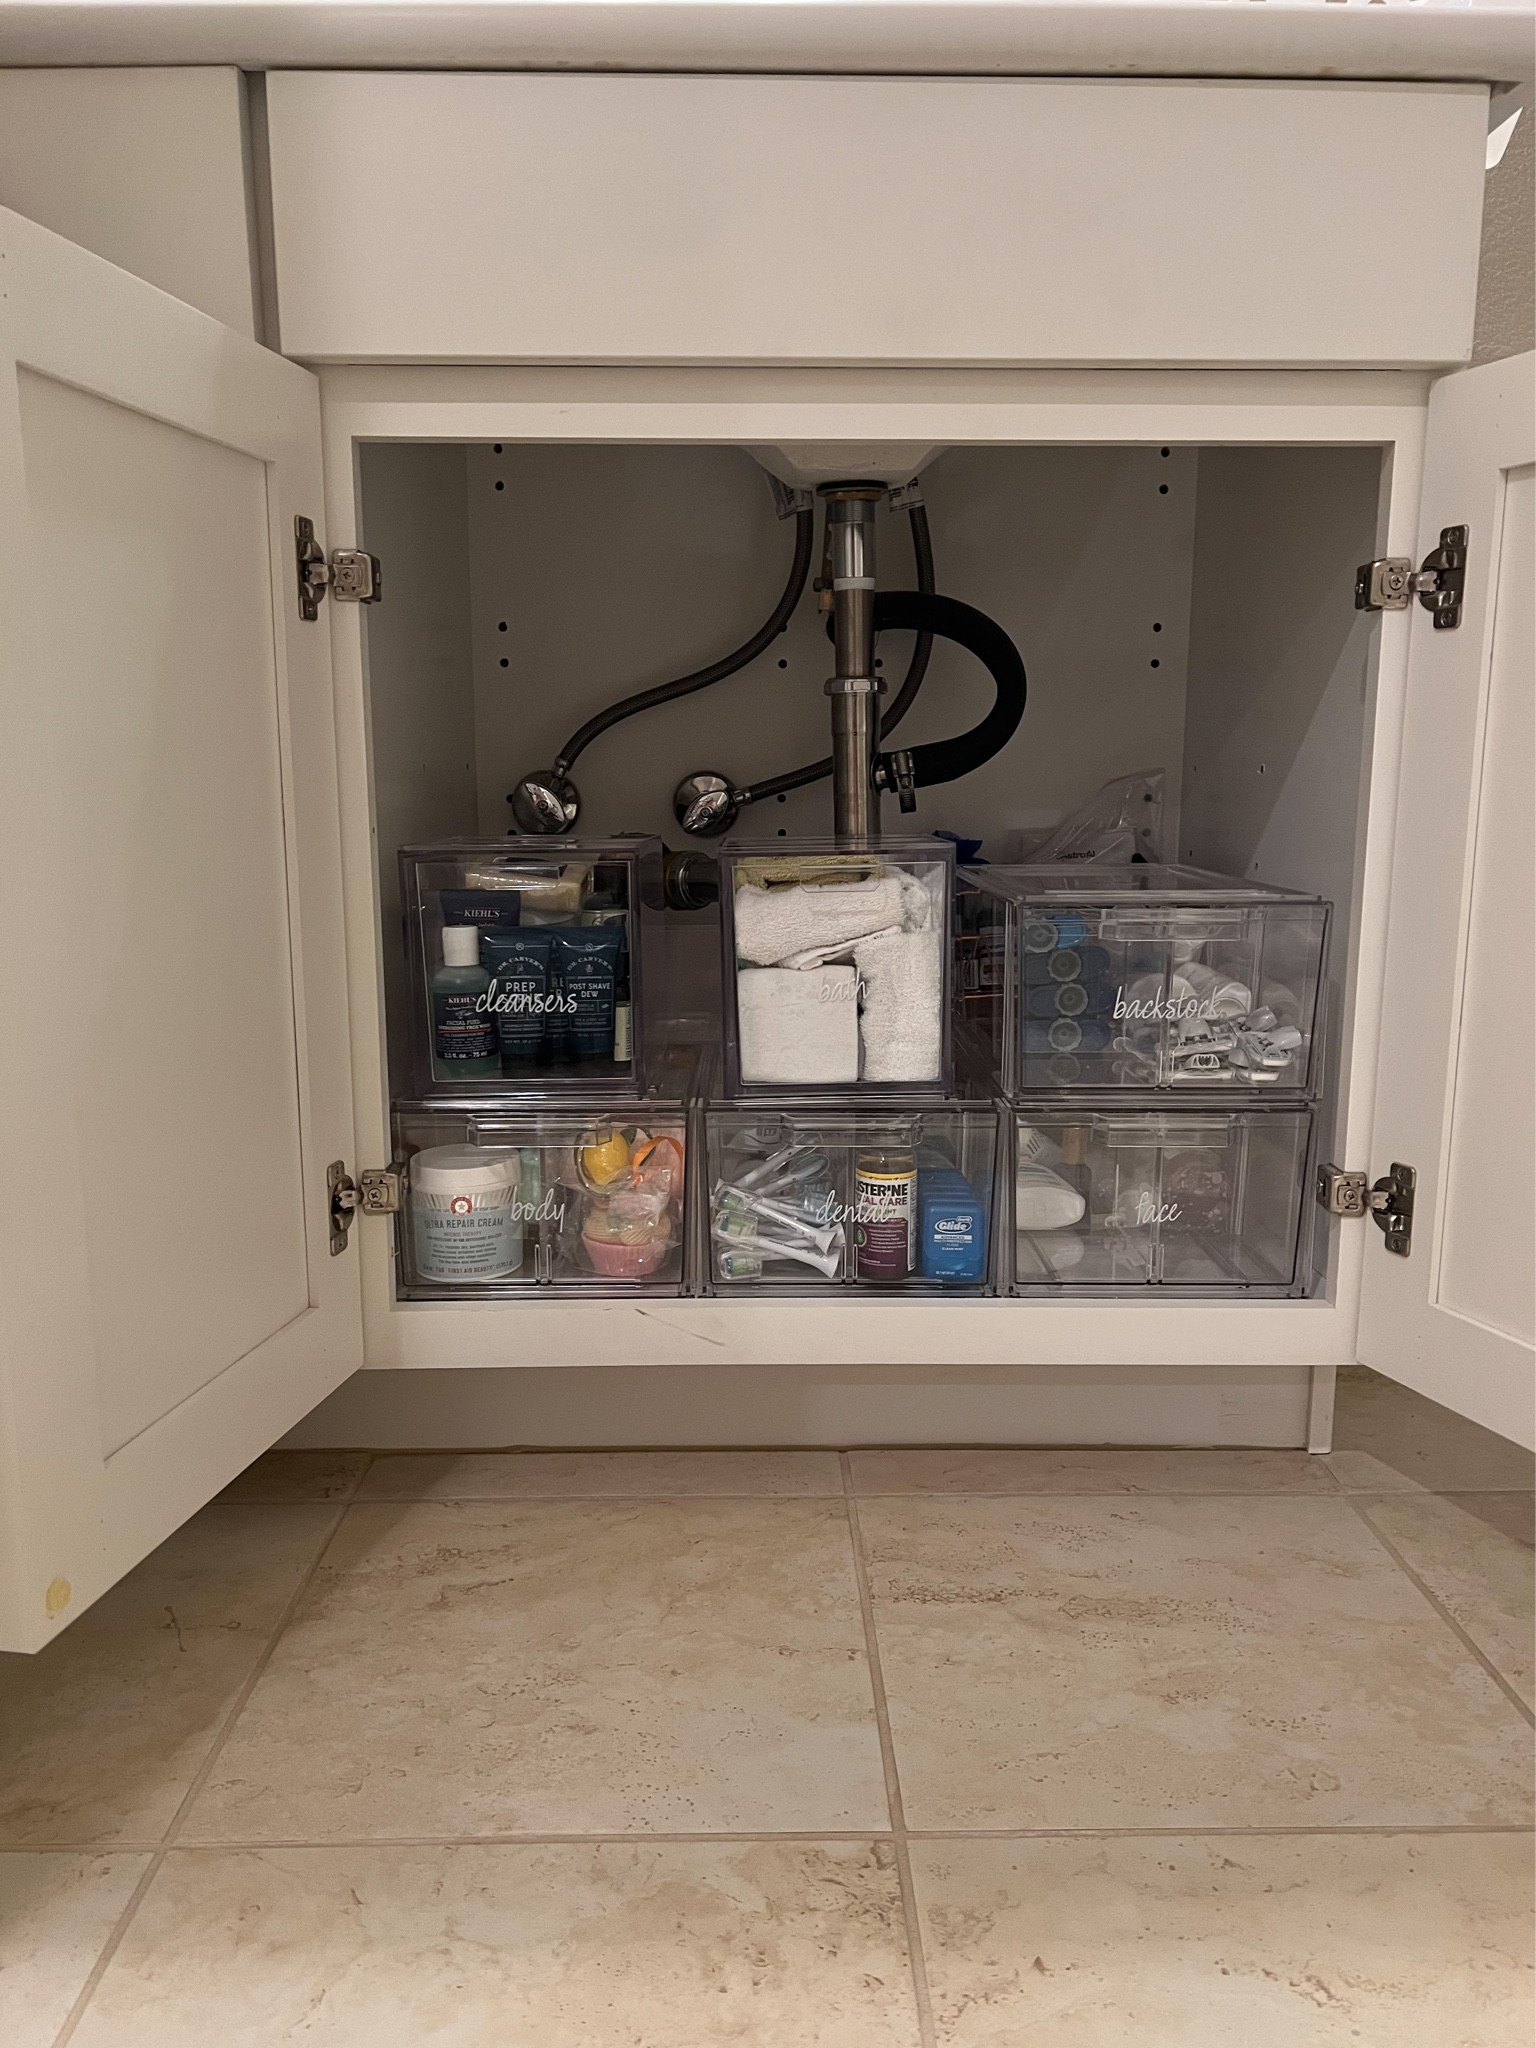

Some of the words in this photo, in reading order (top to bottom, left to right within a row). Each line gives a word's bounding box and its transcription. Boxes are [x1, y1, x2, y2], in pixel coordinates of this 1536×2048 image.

[464, 909, 500, 918] KIEHL'S
[475, 978, 578, 1014] cleansers
[505, 981, 536, 992] PREP
[569, 983, 586, 991] POST
[588, 982, 611, 990] SHAVE
[581, 990, 599, 998] DEW
[818, 966, 870, 1003] bath
[1112, 985, 1221, 1020] backstock
[510, 1184, 565, 1233] body
[816, 1189, 892, 1223] dental
[1134, 1191, 1183, 1225] face
[446, 1218, 474, 1229] REPAIR
[477, 1217, 504, 1228] CREAM
[938, 1220, 967, 1231] Glide
